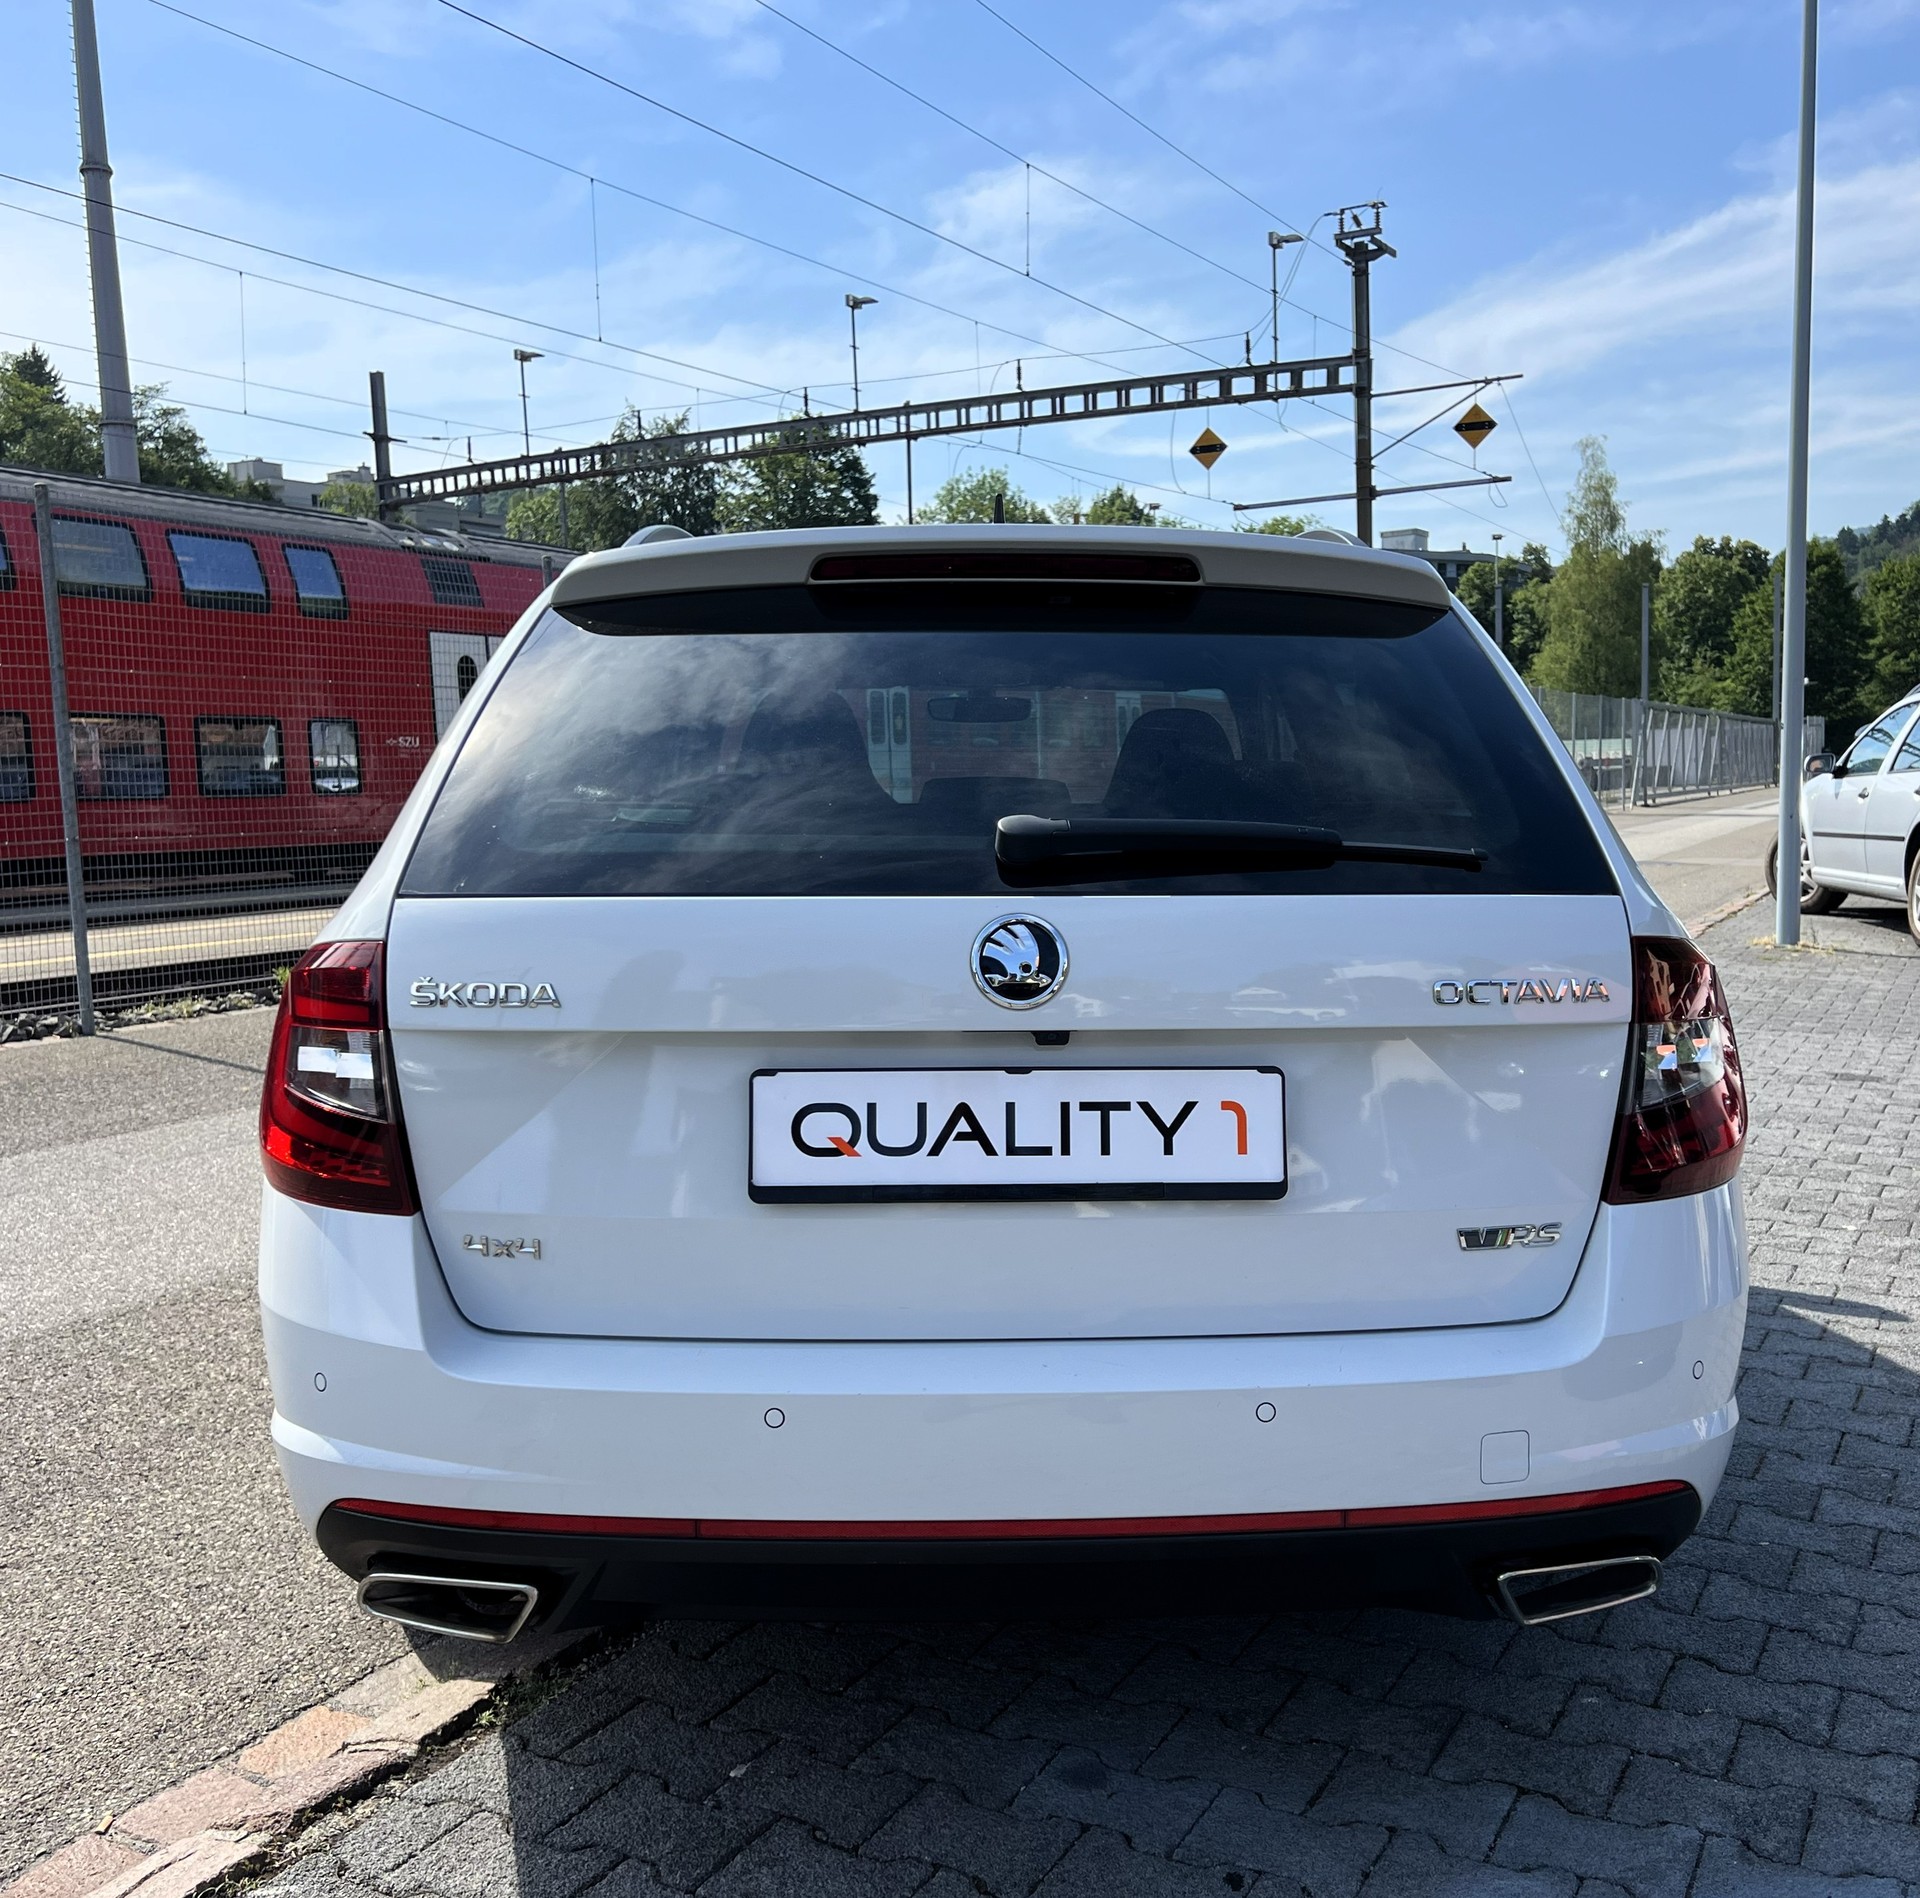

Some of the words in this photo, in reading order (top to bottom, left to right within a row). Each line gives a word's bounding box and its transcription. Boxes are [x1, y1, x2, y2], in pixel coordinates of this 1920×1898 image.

[398, 736, 420, 748] SZU
[410, 976, 562, 1008] ŠKODA
[1432, 977, 1611, 1006] OCTAVIA
[790, 1101, 1200, 1158] QUALITY
[1220, 1100, 1248, 1156] 1
[463, 1234, 542, 1260] 4x4
